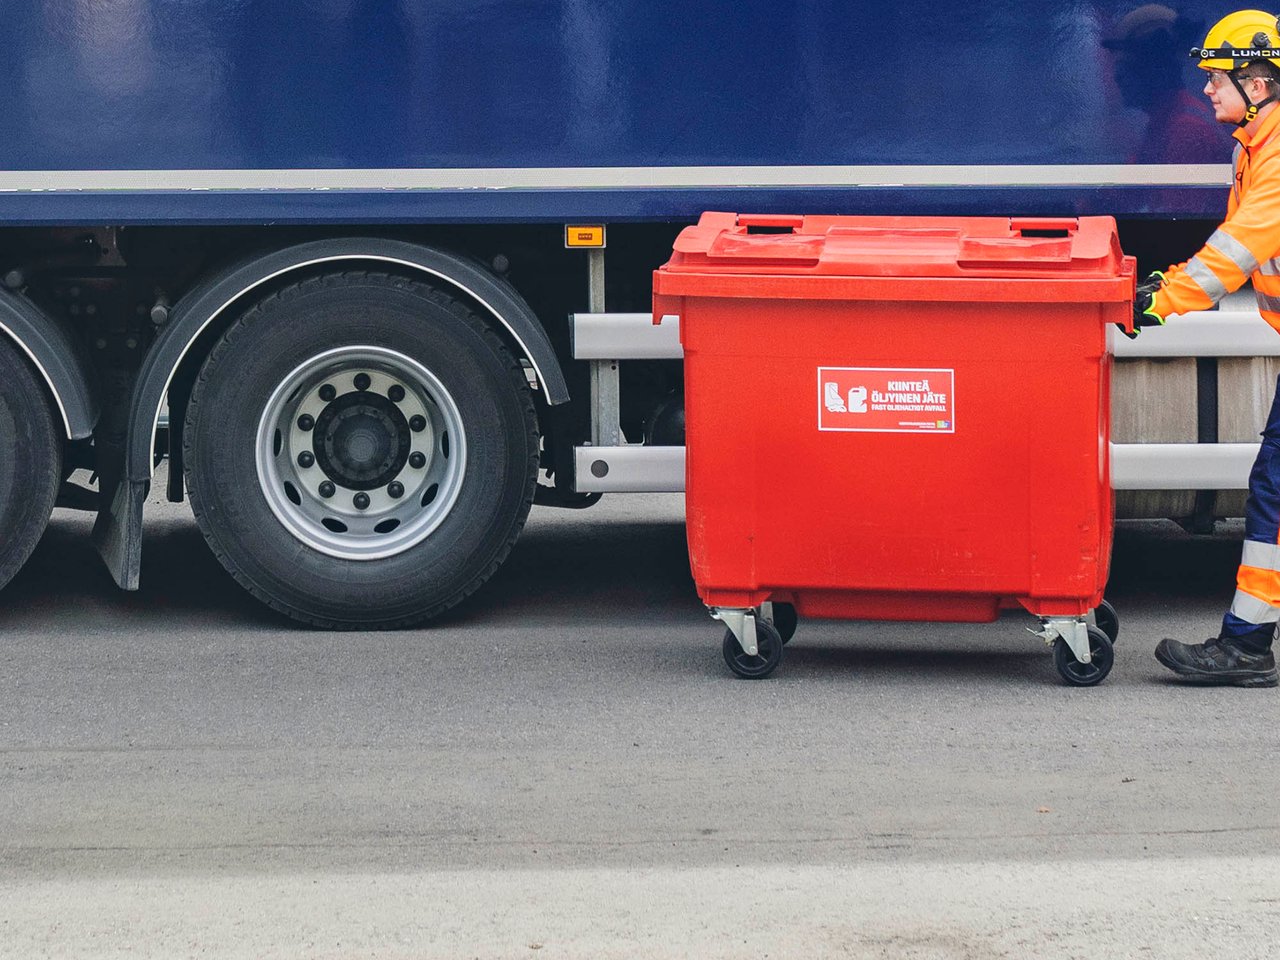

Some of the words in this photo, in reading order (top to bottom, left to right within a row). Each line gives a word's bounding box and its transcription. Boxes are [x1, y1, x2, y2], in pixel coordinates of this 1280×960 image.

[887, 380, 930, 392] KIINTEÄ
[871, 390, 921, 404] ÖLJYINEN
[922, 392, 947, 404] JÄTE
